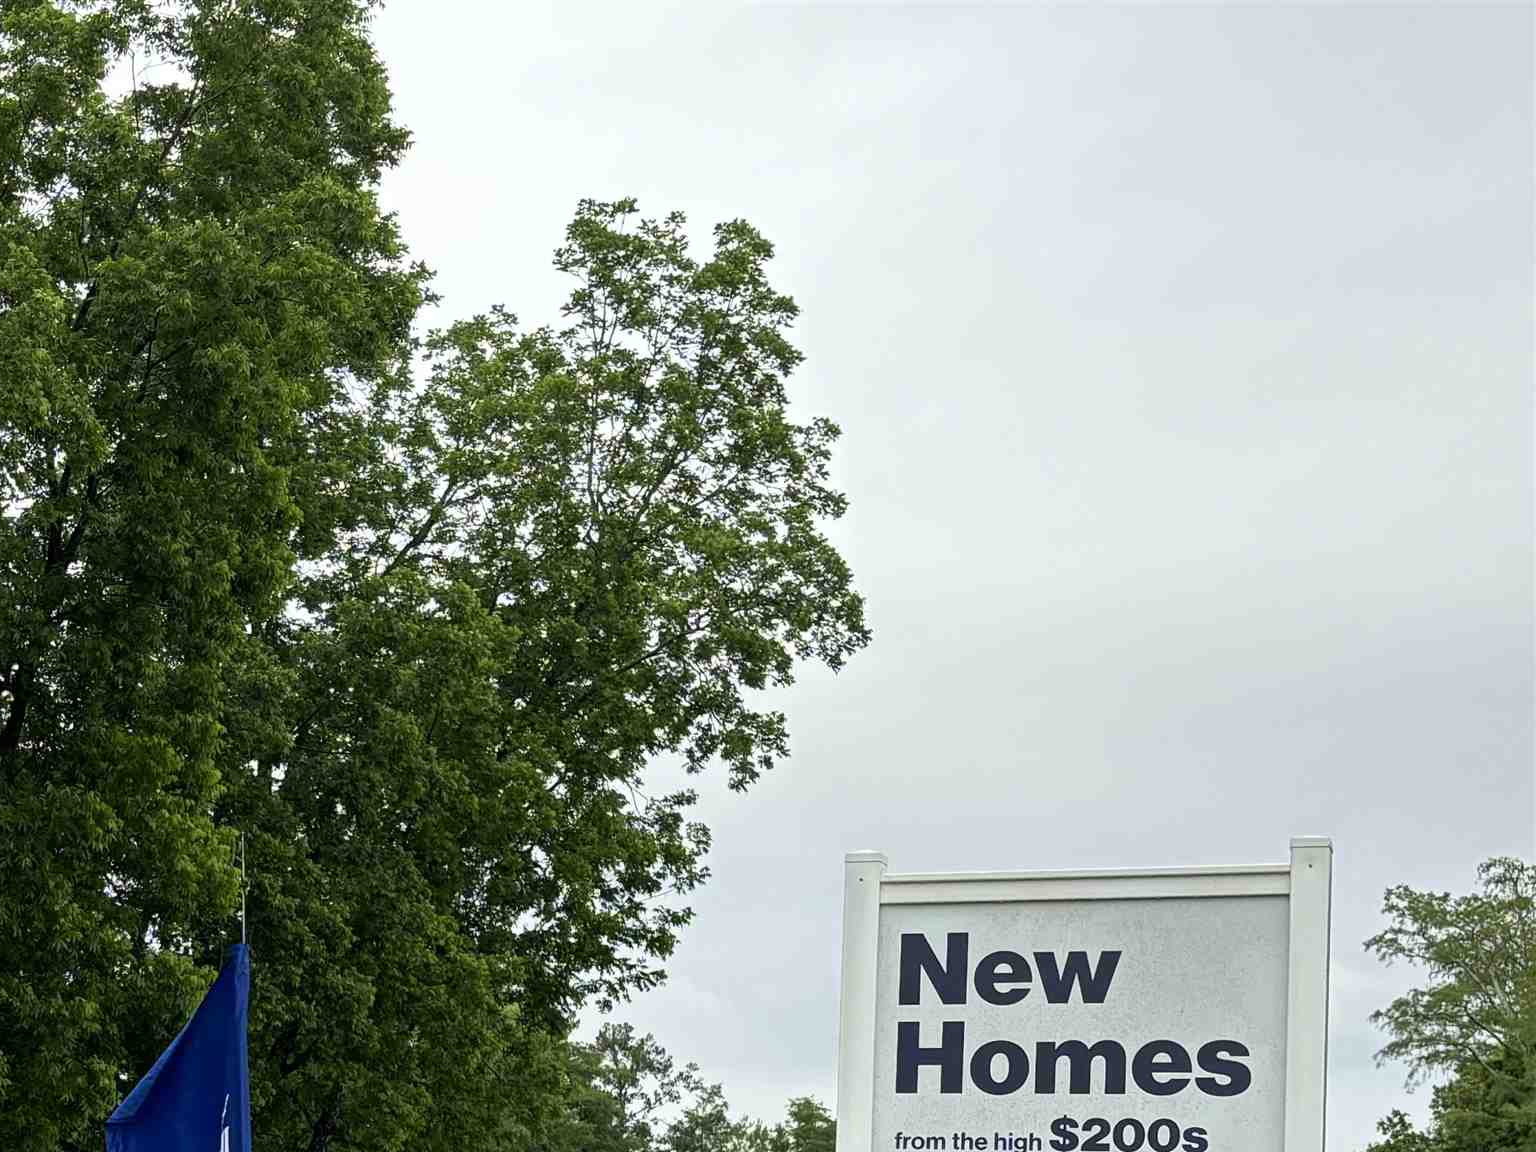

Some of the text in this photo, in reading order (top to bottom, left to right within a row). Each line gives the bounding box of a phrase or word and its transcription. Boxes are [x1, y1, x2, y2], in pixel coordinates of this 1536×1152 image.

[898, 932, 1123, 1006] New
[895, 1020, 1252, 1097] Homes
[894, 1131, 946, 1151] from
[951, 1131, 989, 1151] the
